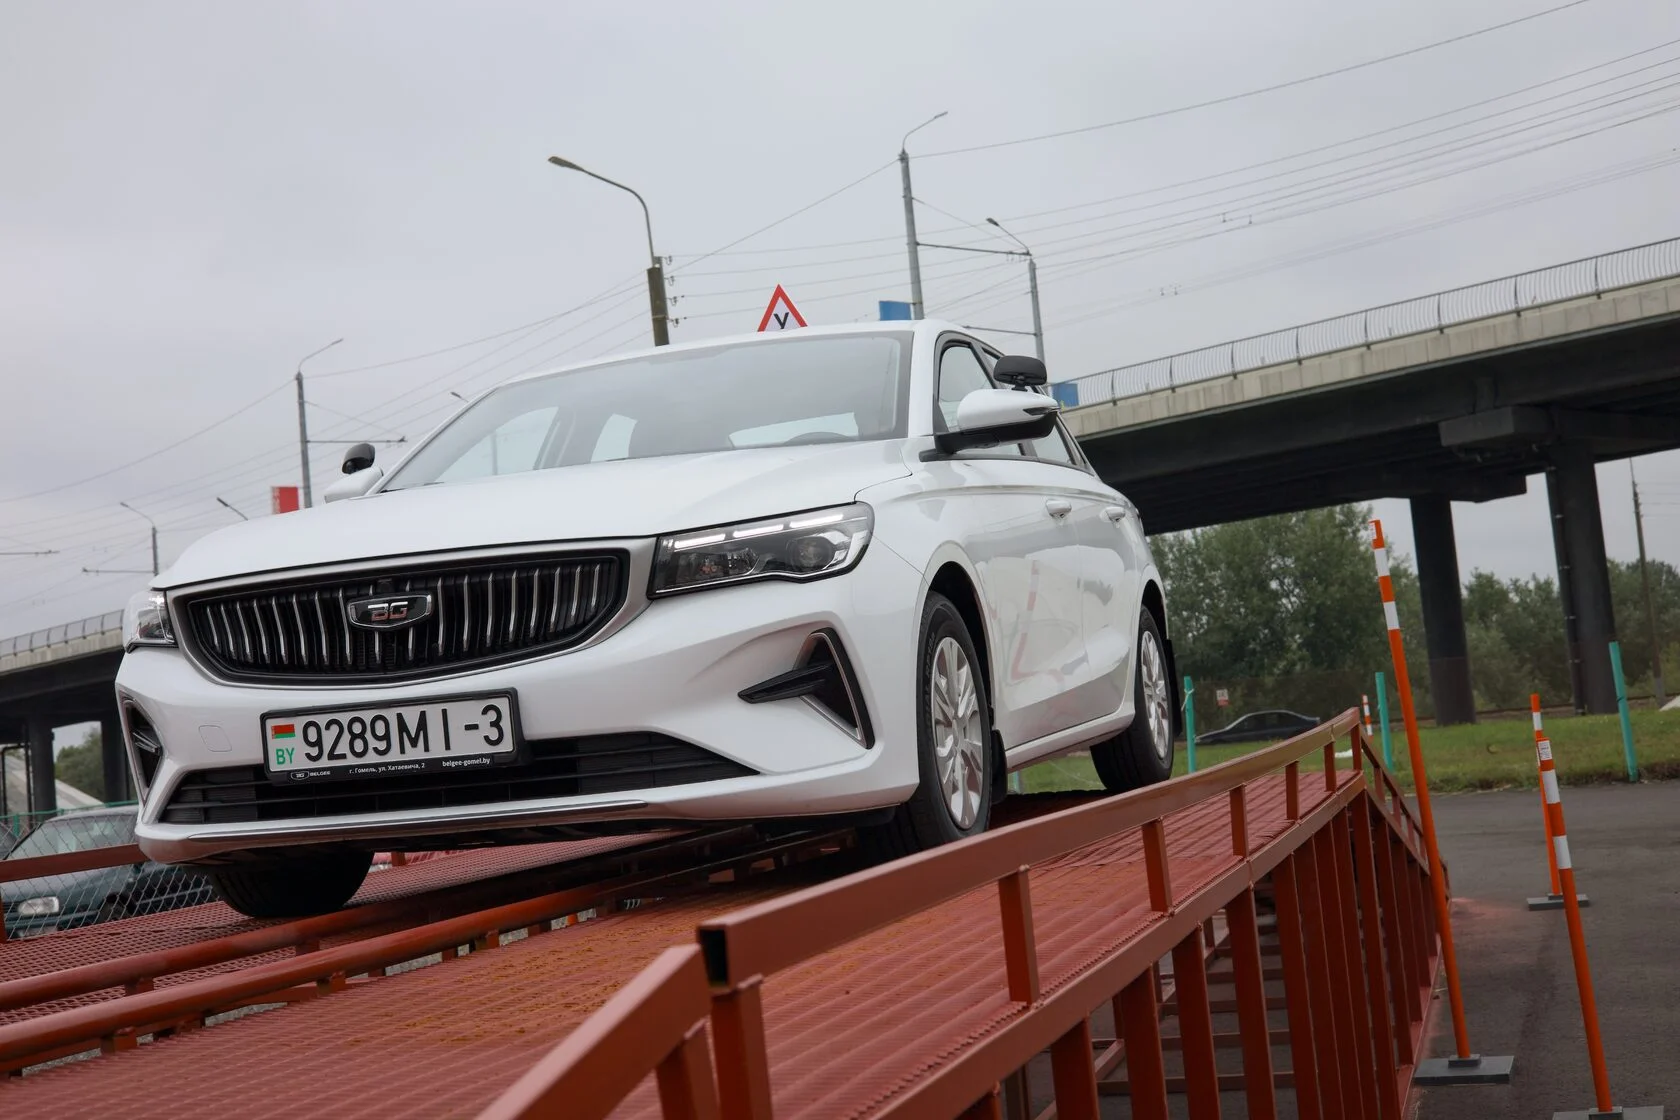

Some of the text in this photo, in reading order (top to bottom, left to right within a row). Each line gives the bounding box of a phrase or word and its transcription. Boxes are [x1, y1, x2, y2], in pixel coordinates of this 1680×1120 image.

[275, 748, 295, 765] BY
[442, 756, 491, 767] belgee-gomel.by
[355, 766, 377, 774] Гомель,
[387, 763, 420, 771] Хатаевича,
